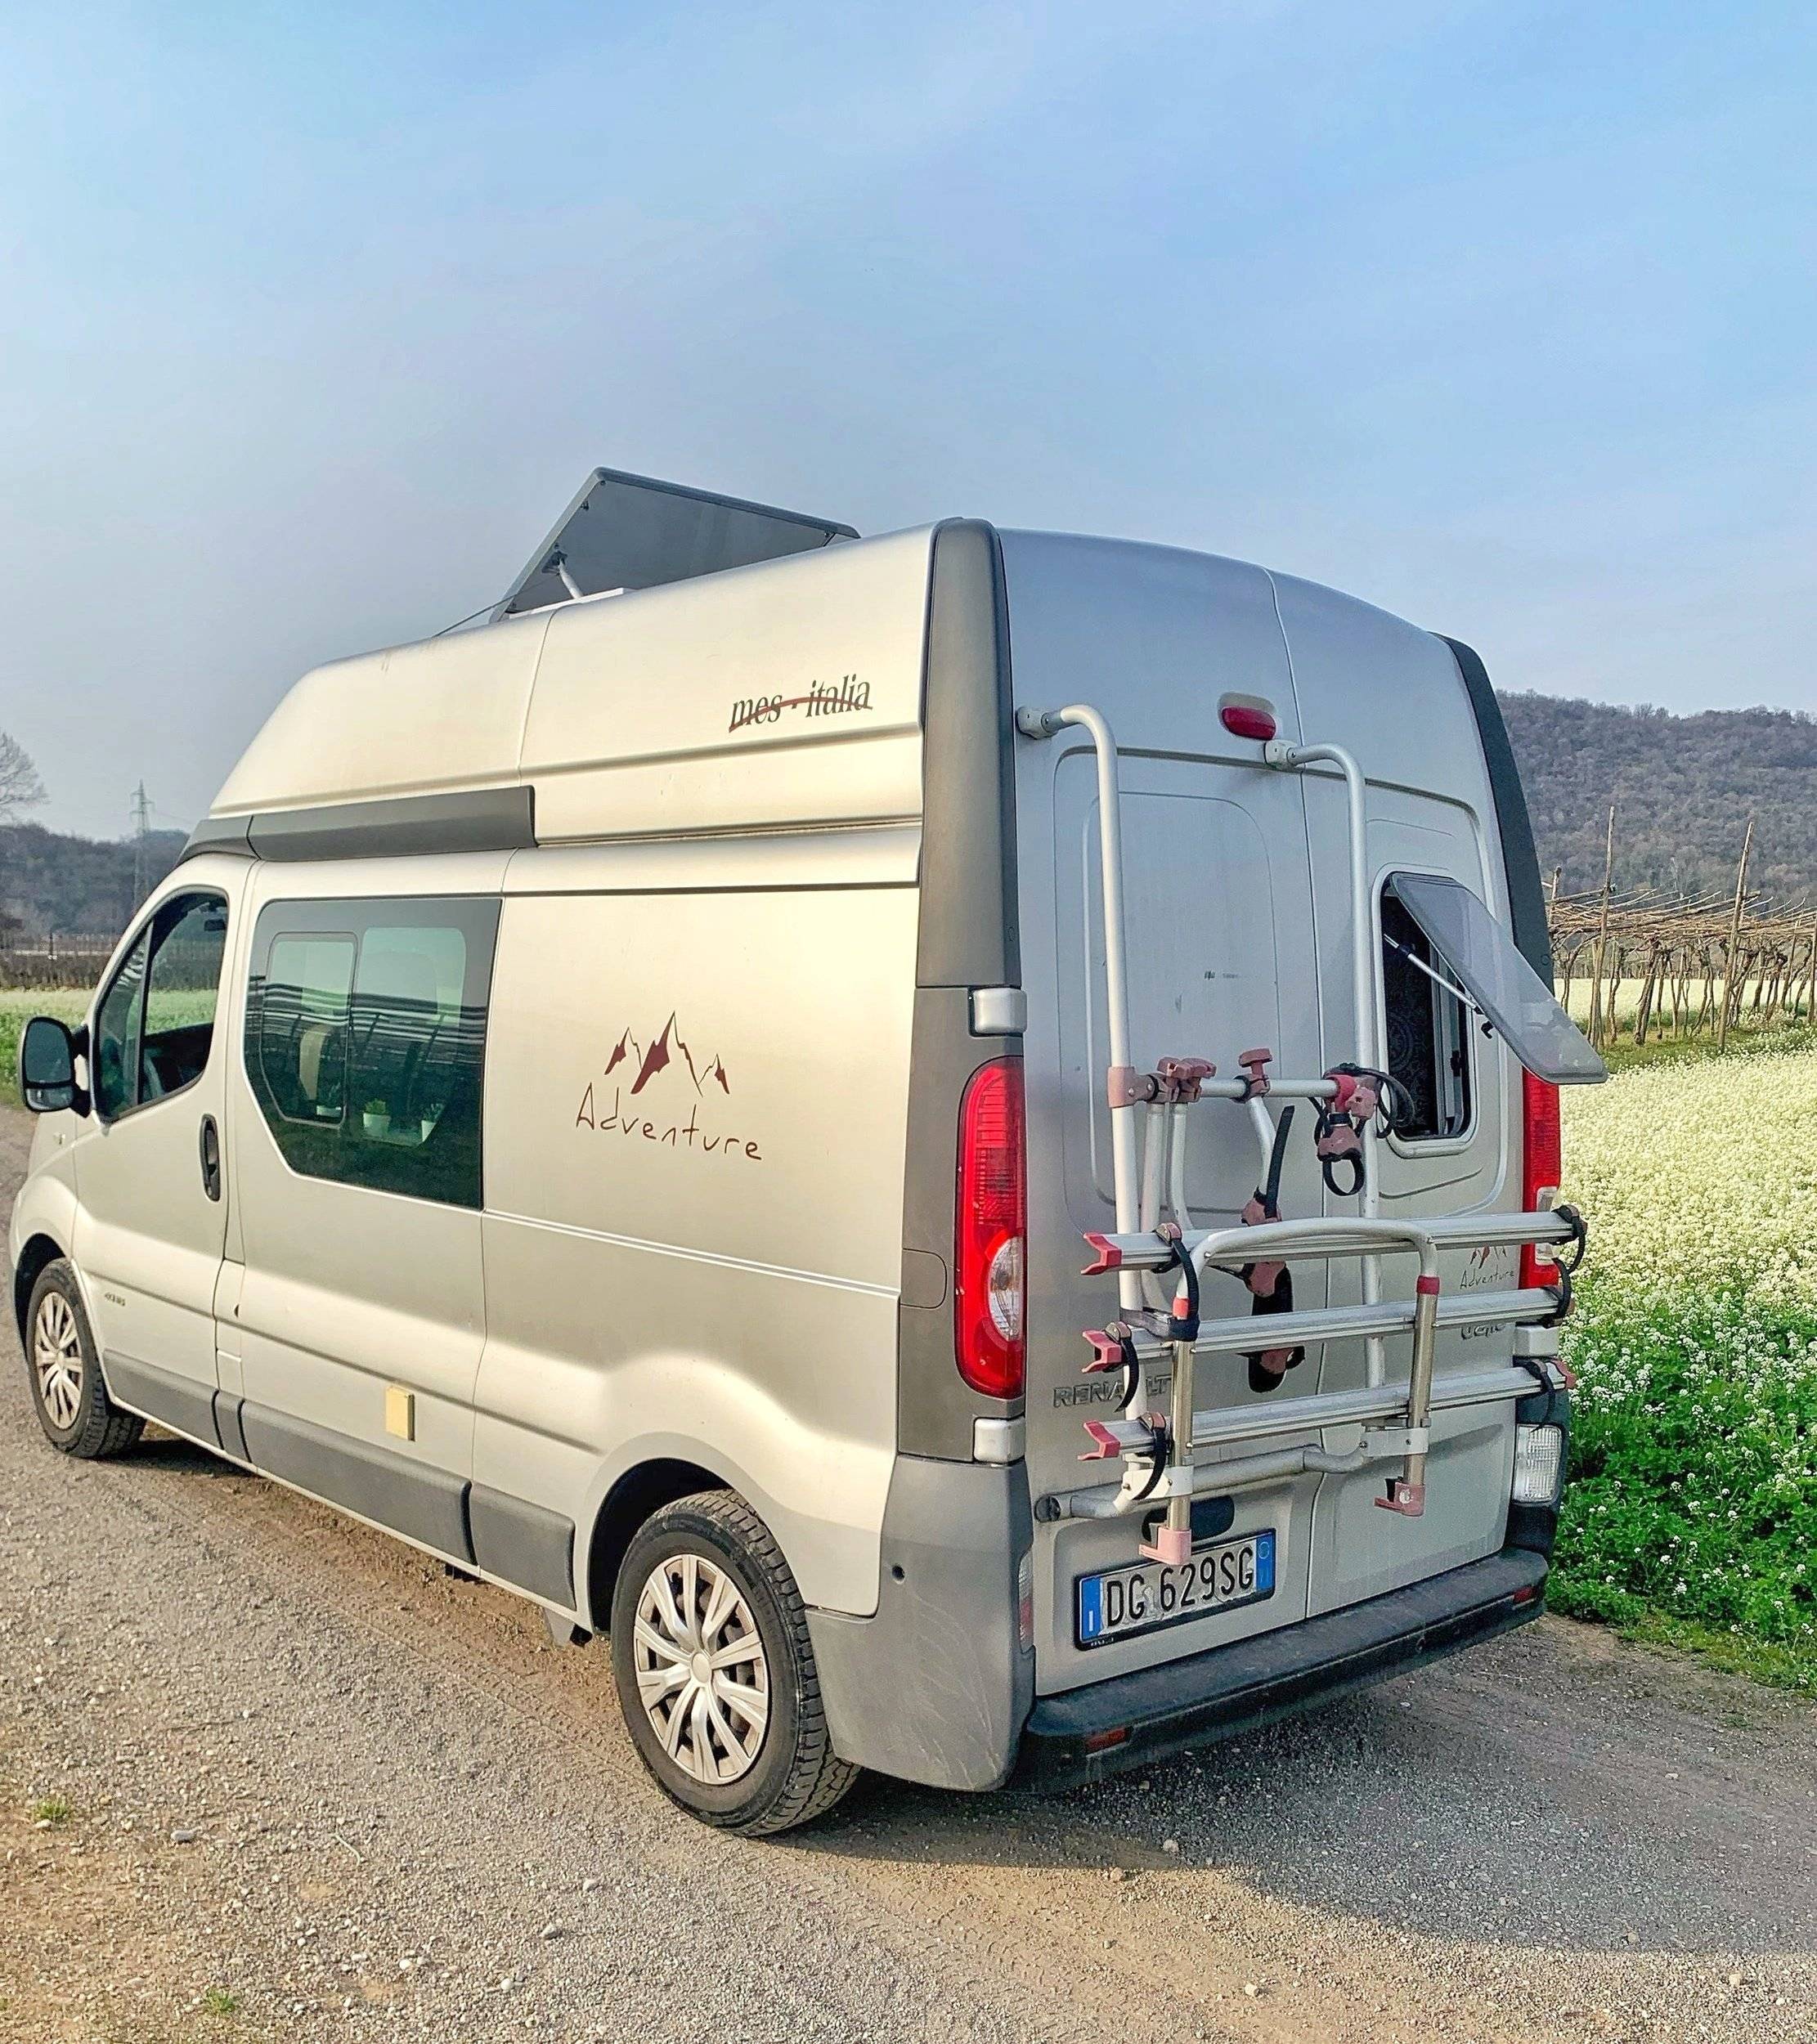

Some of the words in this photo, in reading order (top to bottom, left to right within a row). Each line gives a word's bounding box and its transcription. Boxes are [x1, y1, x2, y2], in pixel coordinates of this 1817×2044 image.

[576, 1082, 762, 1160] Adventure
[1460, 1264, 1514, 1290] Adventure
[1052, 1374, 1173, 1409] RENALT
